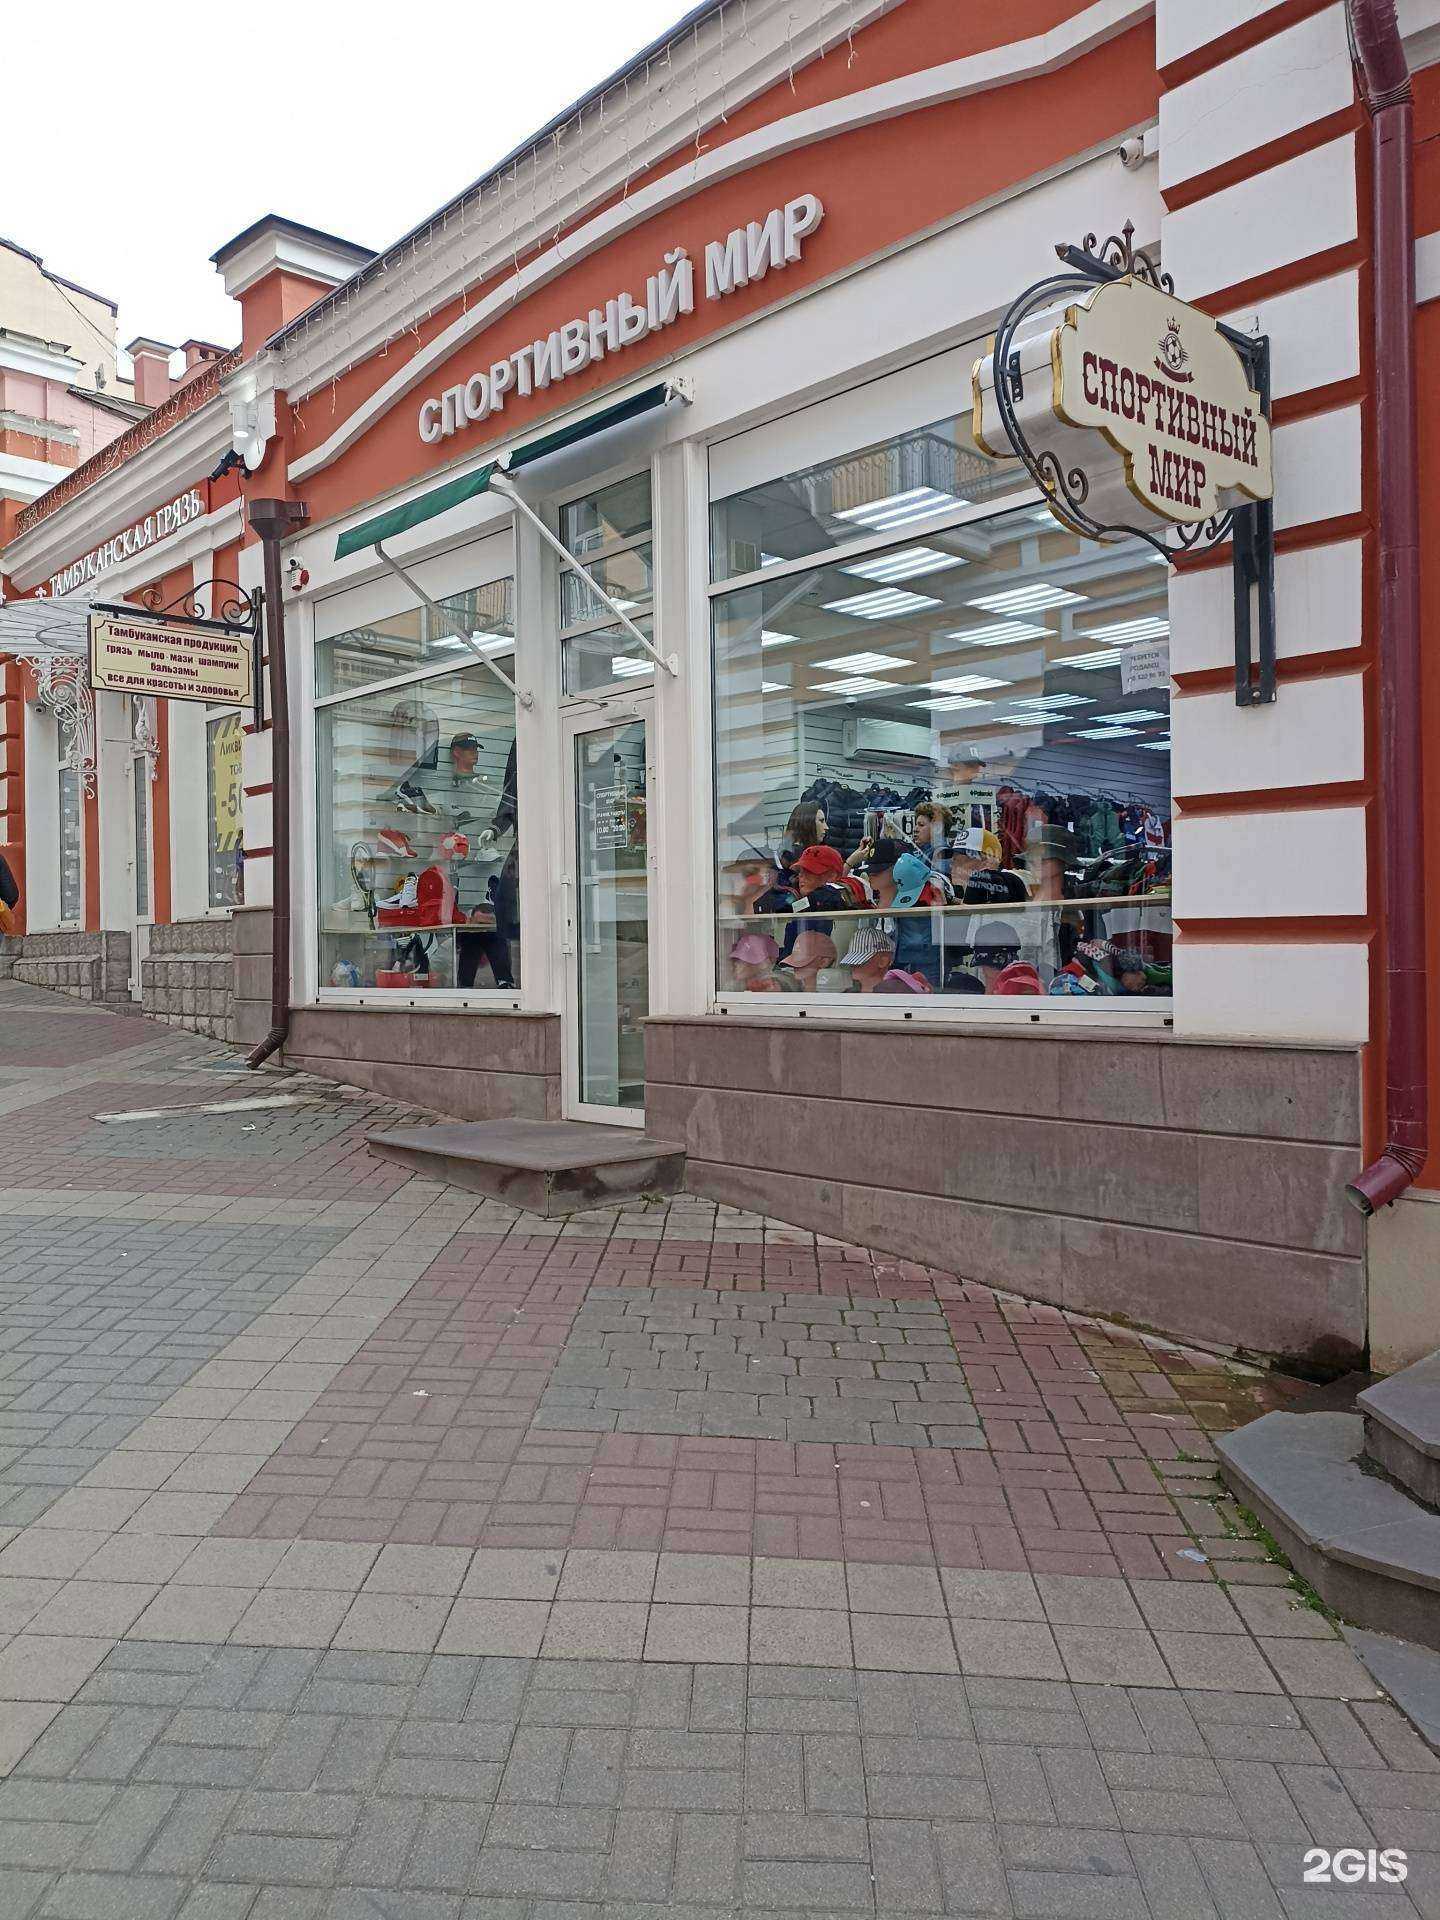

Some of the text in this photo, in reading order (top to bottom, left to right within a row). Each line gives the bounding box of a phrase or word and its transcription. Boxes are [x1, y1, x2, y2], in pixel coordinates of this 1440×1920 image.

[418, 193, 824, 444] СПОРТИВНЫЙ МИР
[1082, 351, 1258, 467] СПОРТИВНЫЙ
[1148, 443, 1207, 508] МИР
[50, 489, 204, 598] ТАМБУКАНСКАЯ ГРЯЗЬ
[106, 644, 240, 670] грязь мыло мази шампуни
[108, 625, 238, 654] Тамбуканская продукция
[107, 673, 240, 698] все для красоты и здоровья
[150, 662, 199, 677] бальзамы
